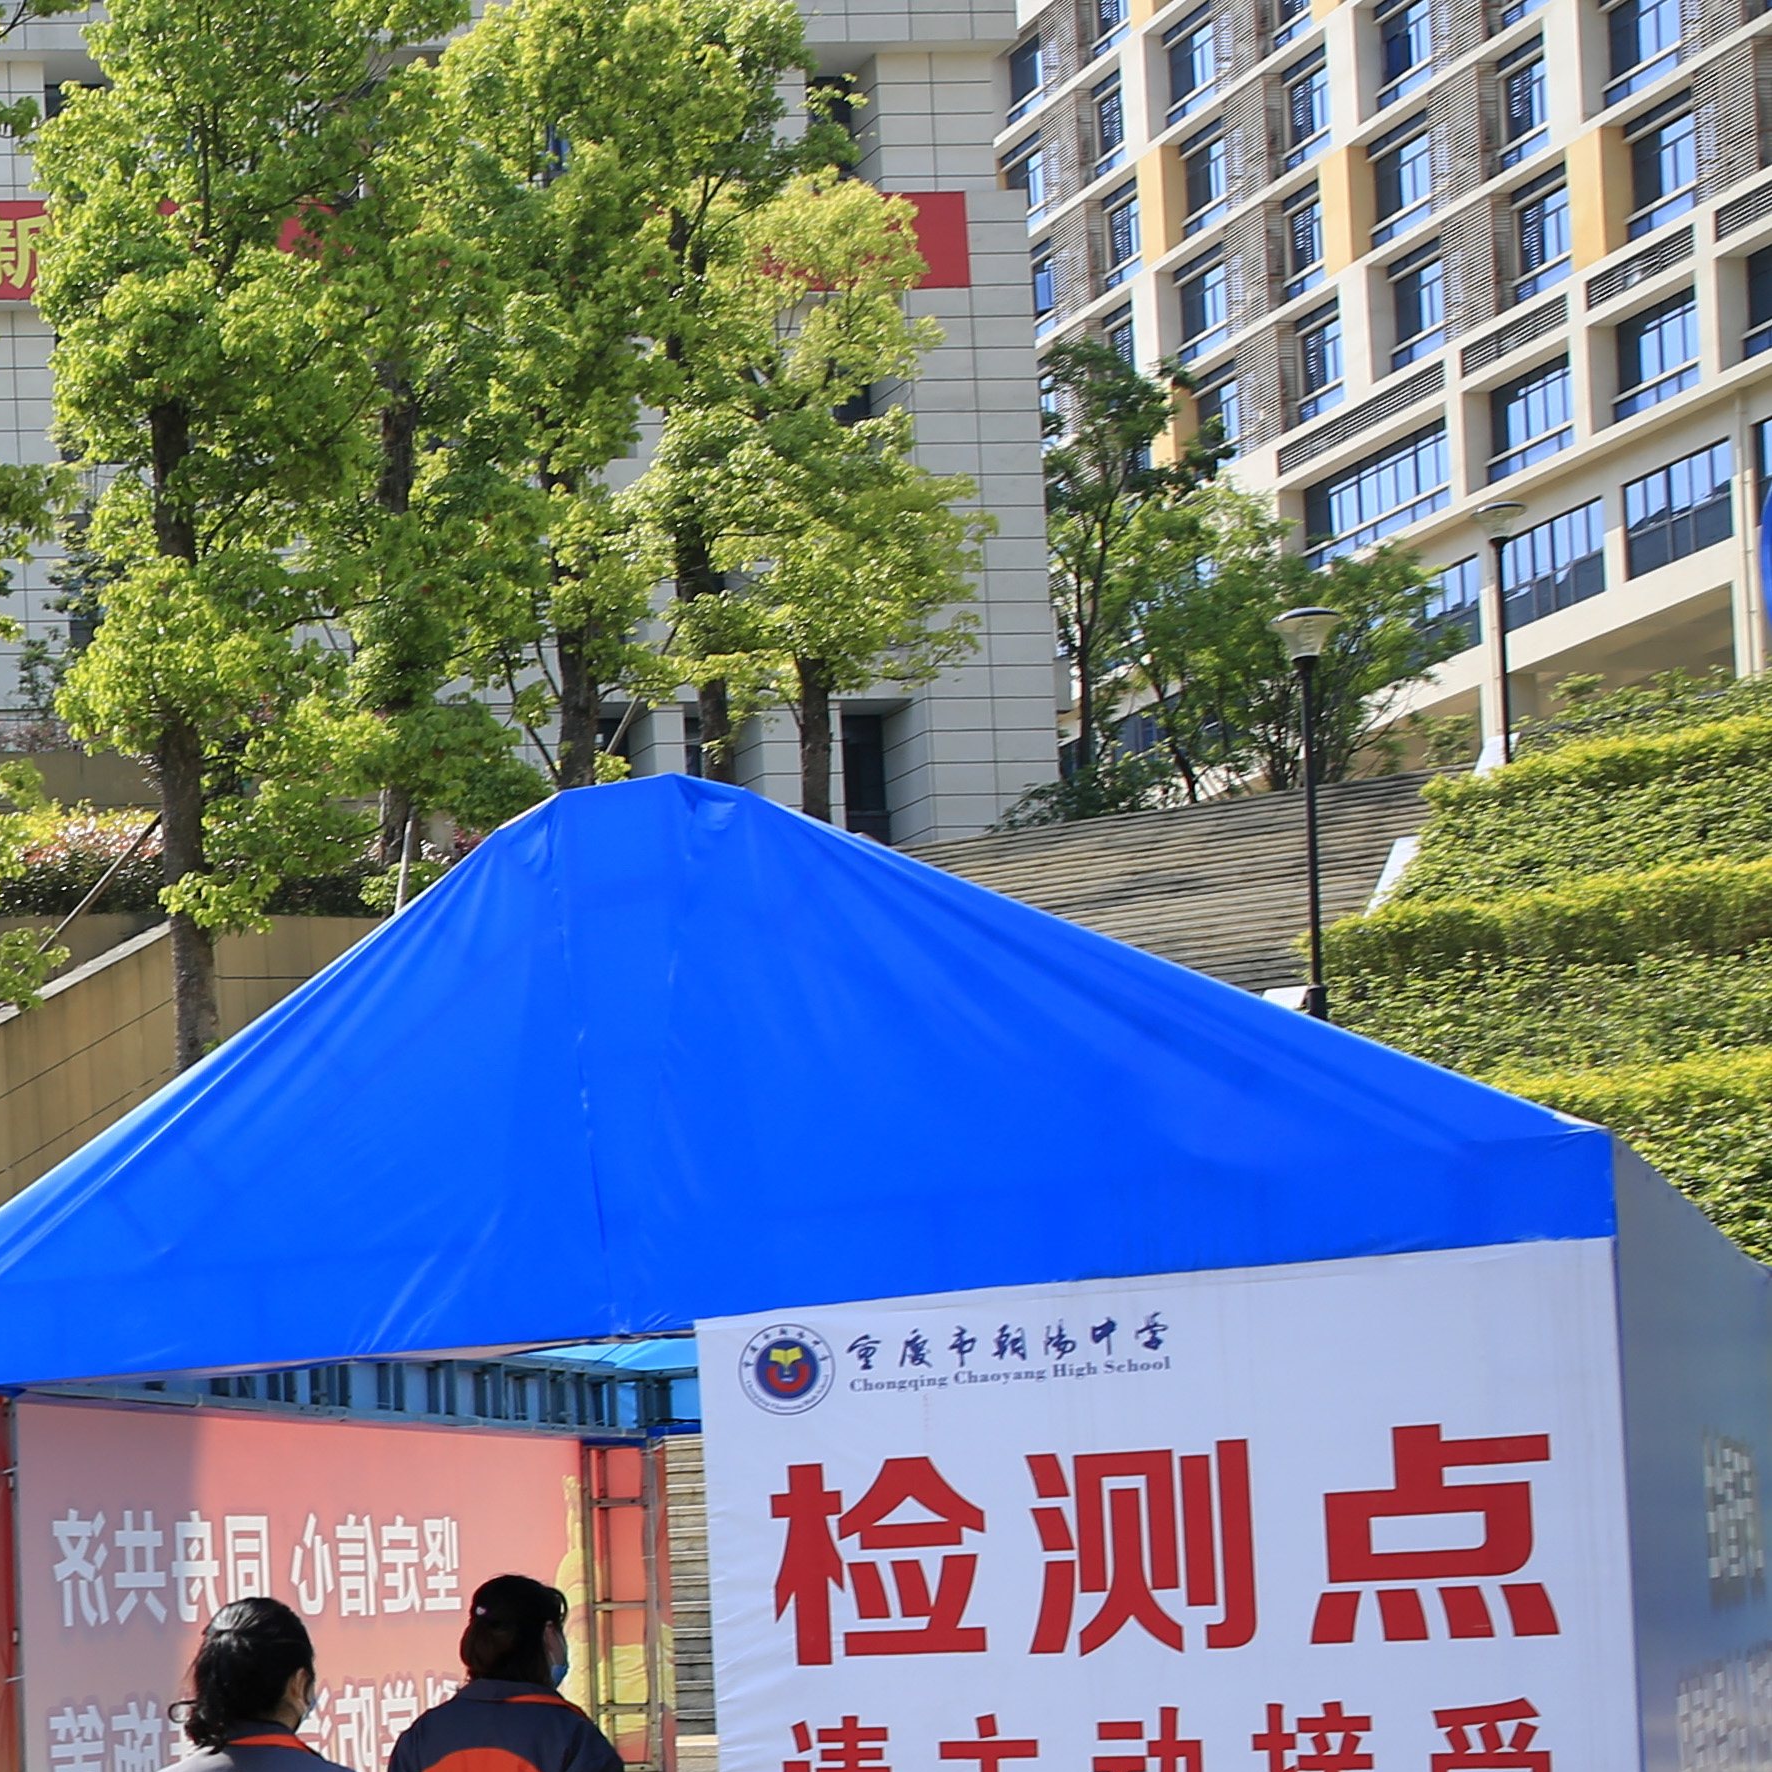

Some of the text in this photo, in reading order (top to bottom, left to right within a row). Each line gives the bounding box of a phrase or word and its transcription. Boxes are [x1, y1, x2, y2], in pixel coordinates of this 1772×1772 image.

[849, 1374, 949, 1395] Chongqing
[954, 1367, 1046, 1387] Chaoyang
[1053, 1361, 1098, 1380] High
[1103, 1356, 1171, 1375] School
[770, 1423, 1561, 1667] 检测点
